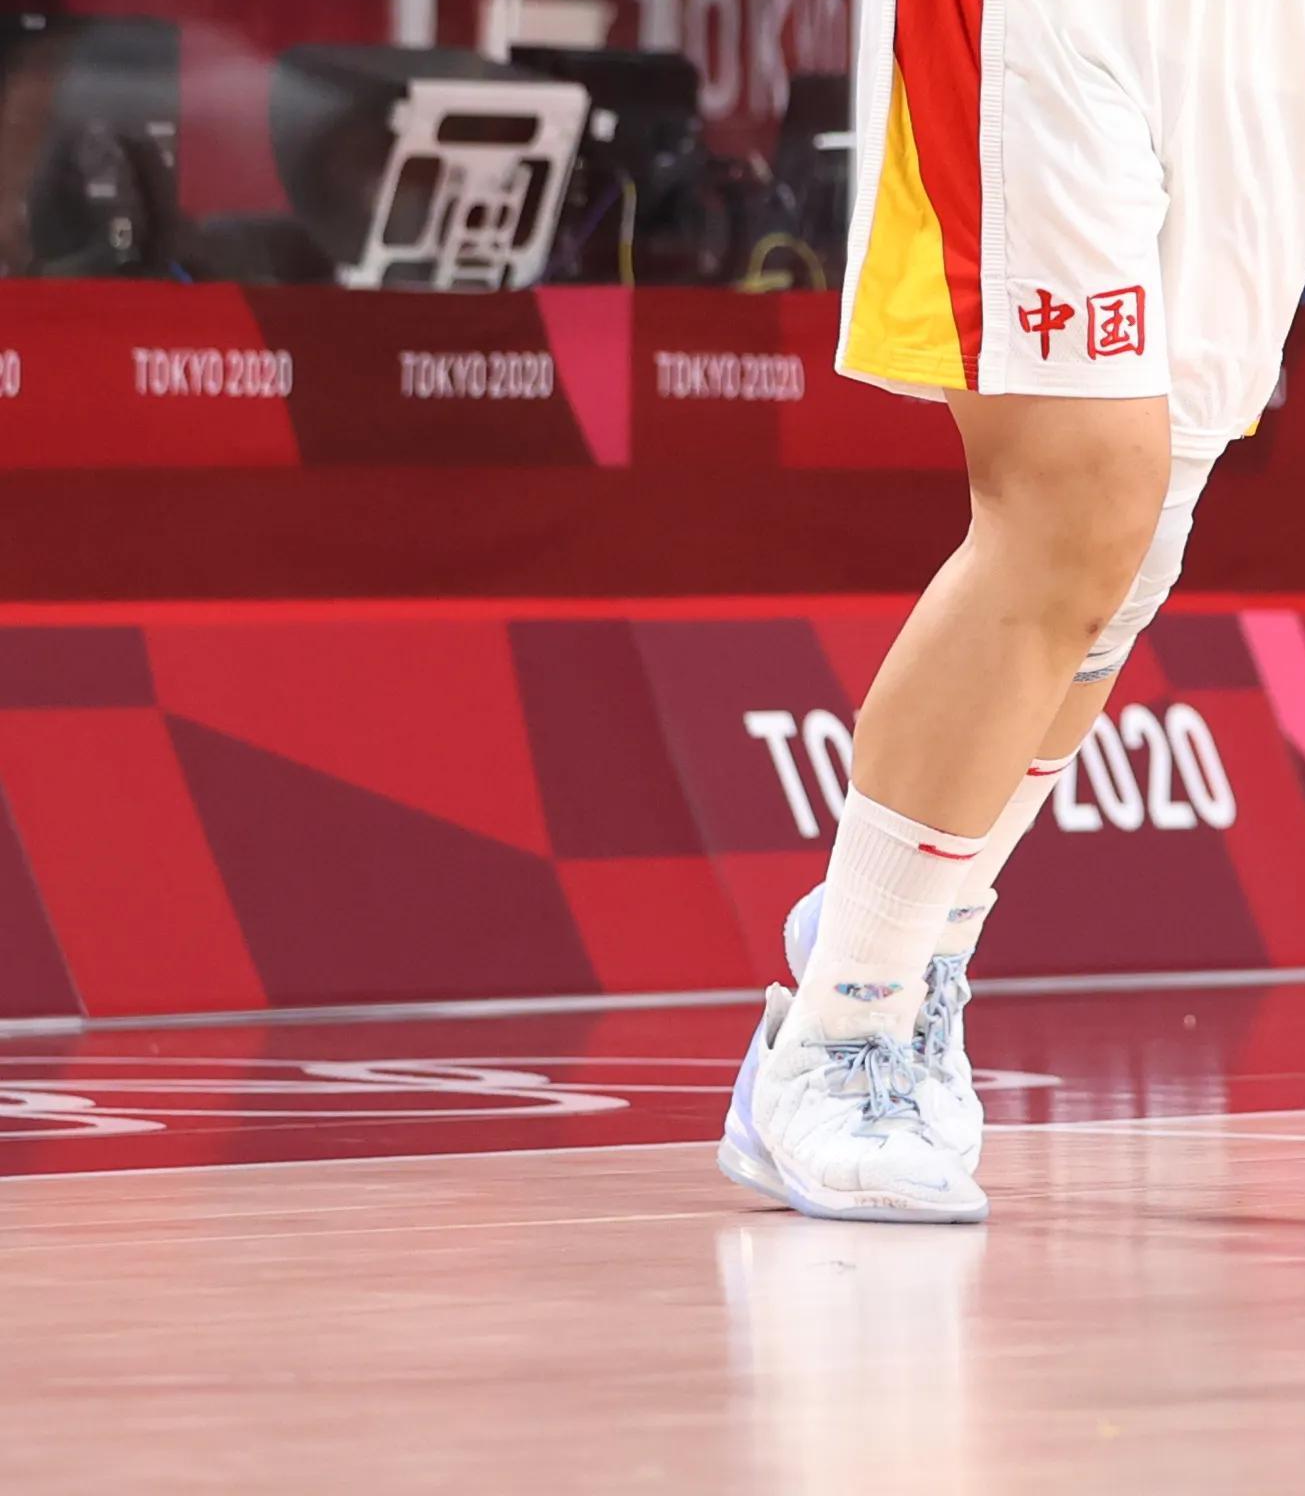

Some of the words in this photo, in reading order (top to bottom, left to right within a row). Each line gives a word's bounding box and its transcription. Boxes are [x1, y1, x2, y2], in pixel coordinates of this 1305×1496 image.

[1018, 285, 1146, 361] 中国
[132, 347, 223, 396] TOKYO
[225, 349, 293, 398] 2020
[399, 350, 487, 398] TOKYO
[488, 351, 554, 399] 2020
[655, 352, 741, 399] TOKYO
[742, 353, 805, 401] 2020
